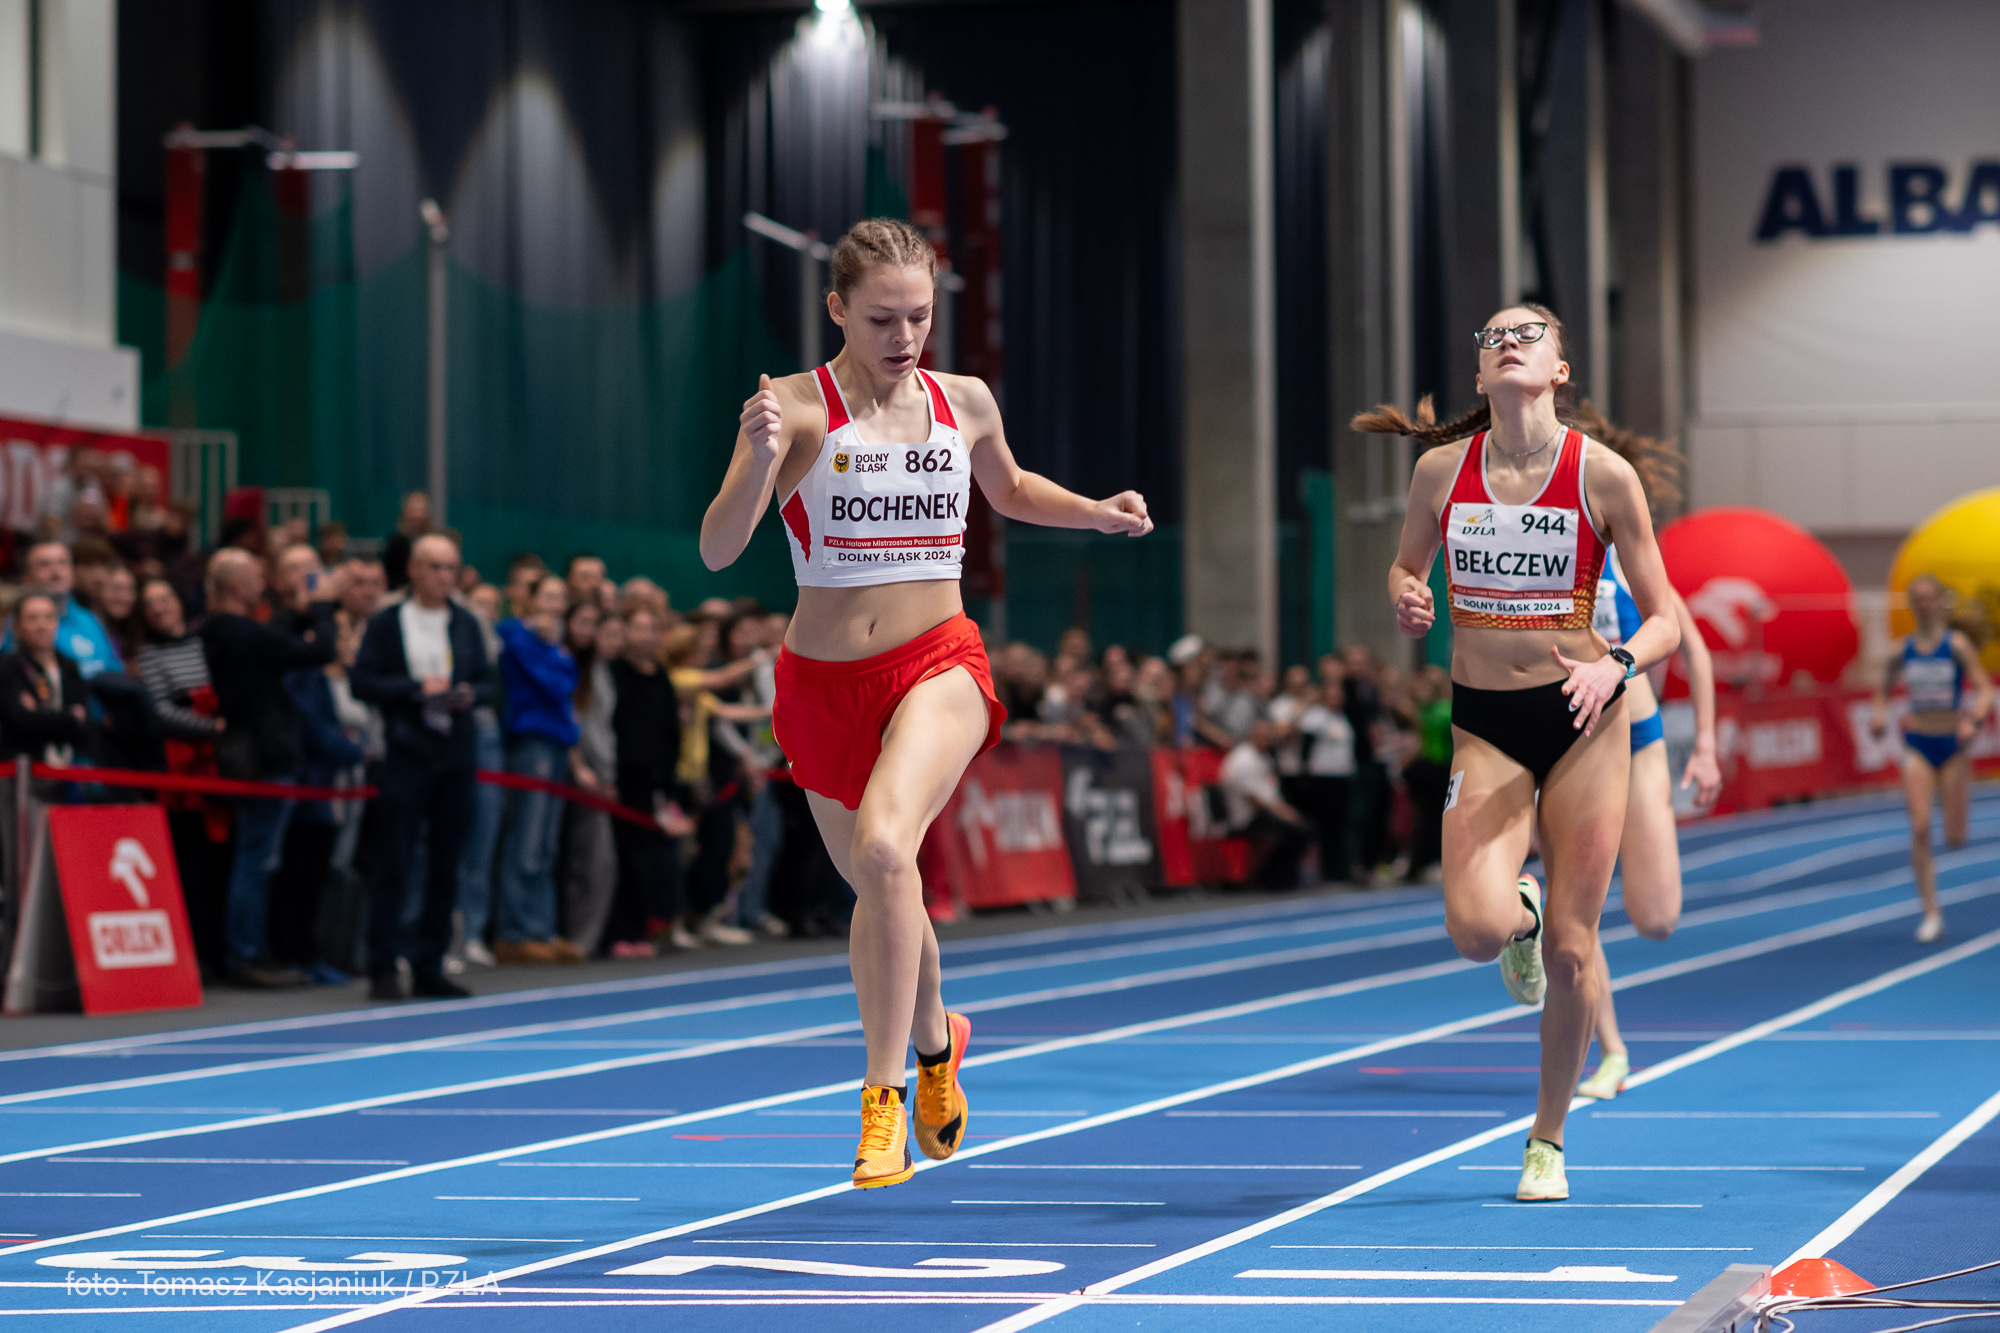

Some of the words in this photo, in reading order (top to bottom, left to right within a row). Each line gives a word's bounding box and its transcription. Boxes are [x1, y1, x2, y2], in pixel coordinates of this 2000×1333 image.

[855, 453, 890, 463] DOLNY
[905, 448, 953, 473] 862
[855, 462, 888, 473] ŚLĄSK
[831, 492, 959, 522] BOCHENEK
[1462, 526, 1495, 536] DZLA
[1521, 513, 1566, 535] 944
[872, 539, 913, 547] Mistrzostwa
[914, 538, 934, 546] Polski
[934, 537, 946, 545] U18
[838, 552, 881, 562] DOLNY
[883, 550, 922, 563] ŚLĄSK
[924, 551, 951, 560] 2024
[1455, 549, 1570, 577] BEŁCZEW
[1463, 599, 1495, 611] DOLNY
[1496, 600, 1531, 614] ŚLĄSK
[1533, 603, 1561, 611] 2024
[603, 1255, 1067, 1279] 2
[1233, 1266, 1678, 1283] 1
